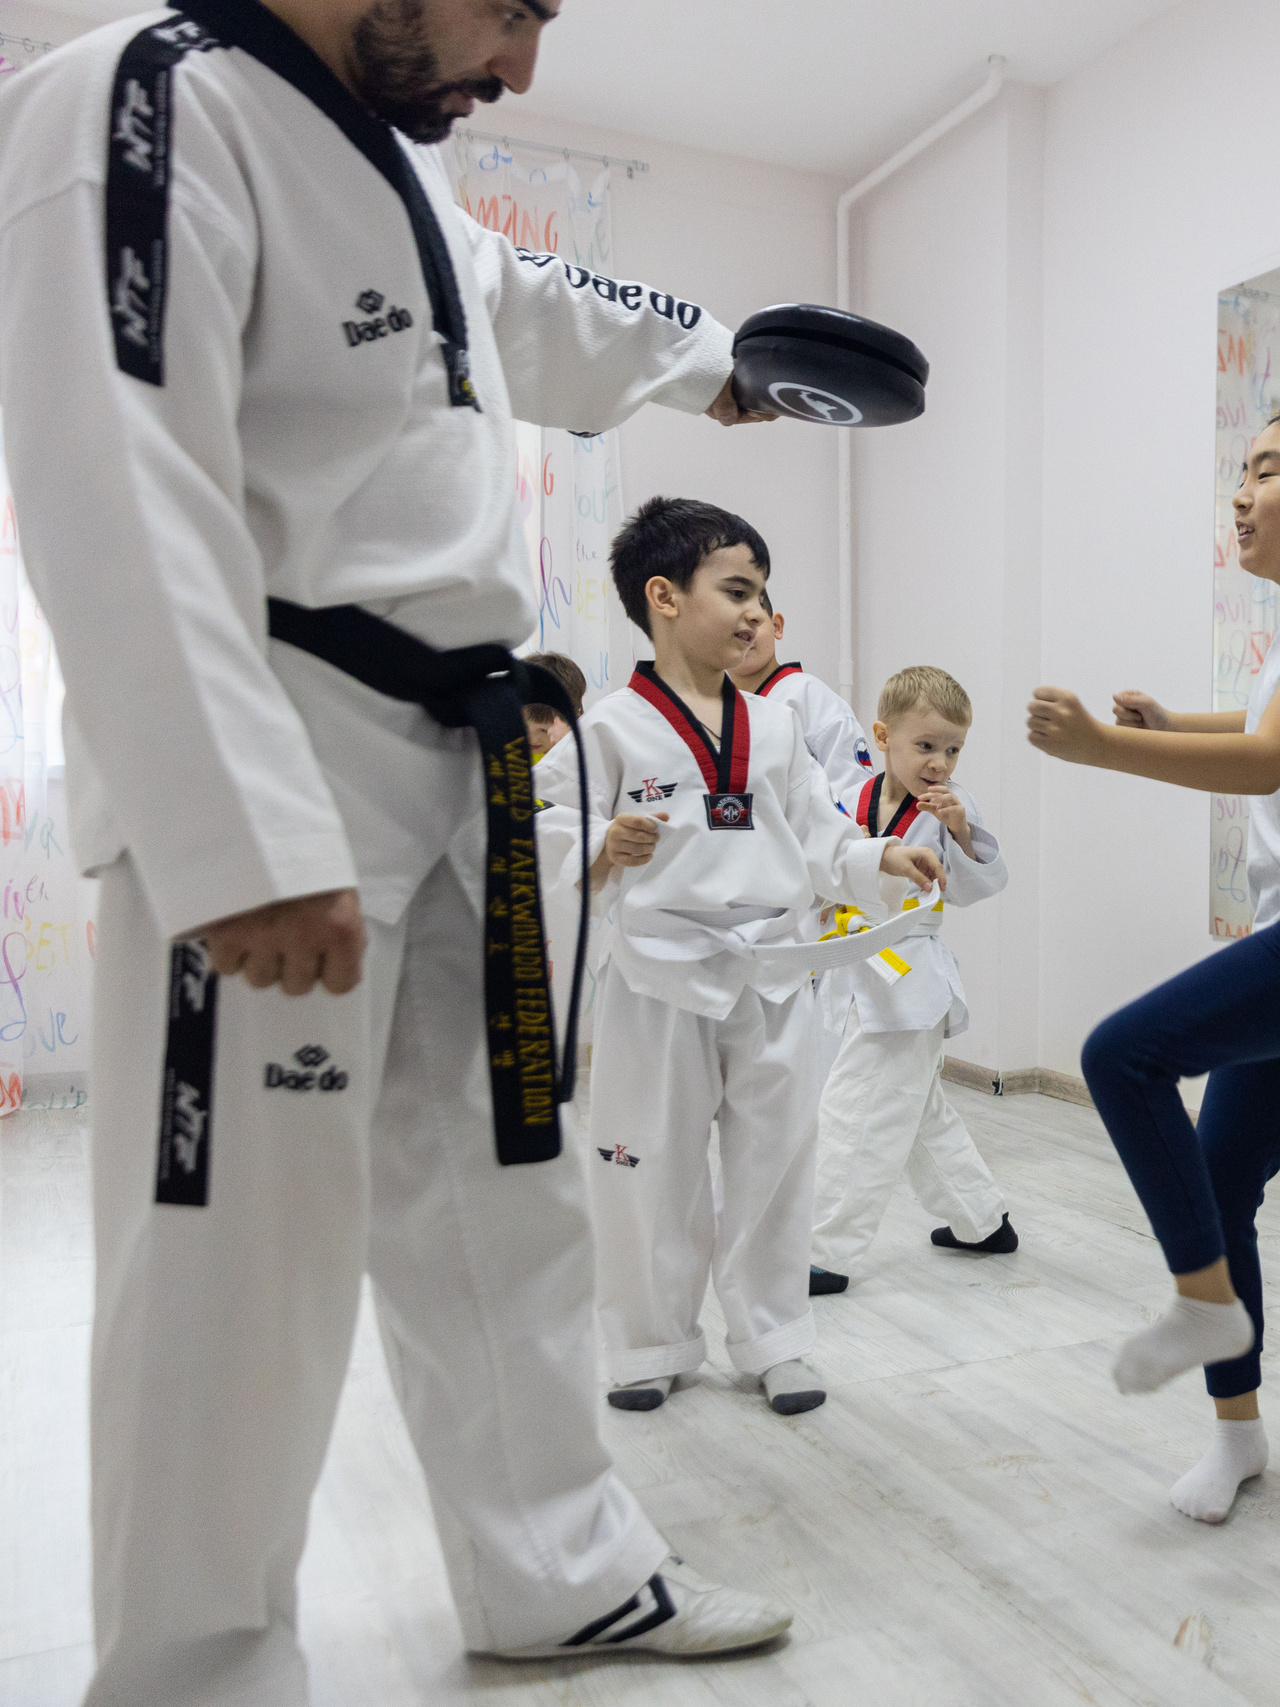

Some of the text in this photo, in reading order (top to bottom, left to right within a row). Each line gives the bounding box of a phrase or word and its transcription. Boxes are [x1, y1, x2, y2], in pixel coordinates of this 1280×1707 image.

[642, 777, 663, 797] K
[504, 736, 553, 1125] WORLD TAEKWONDO FEDERATION
